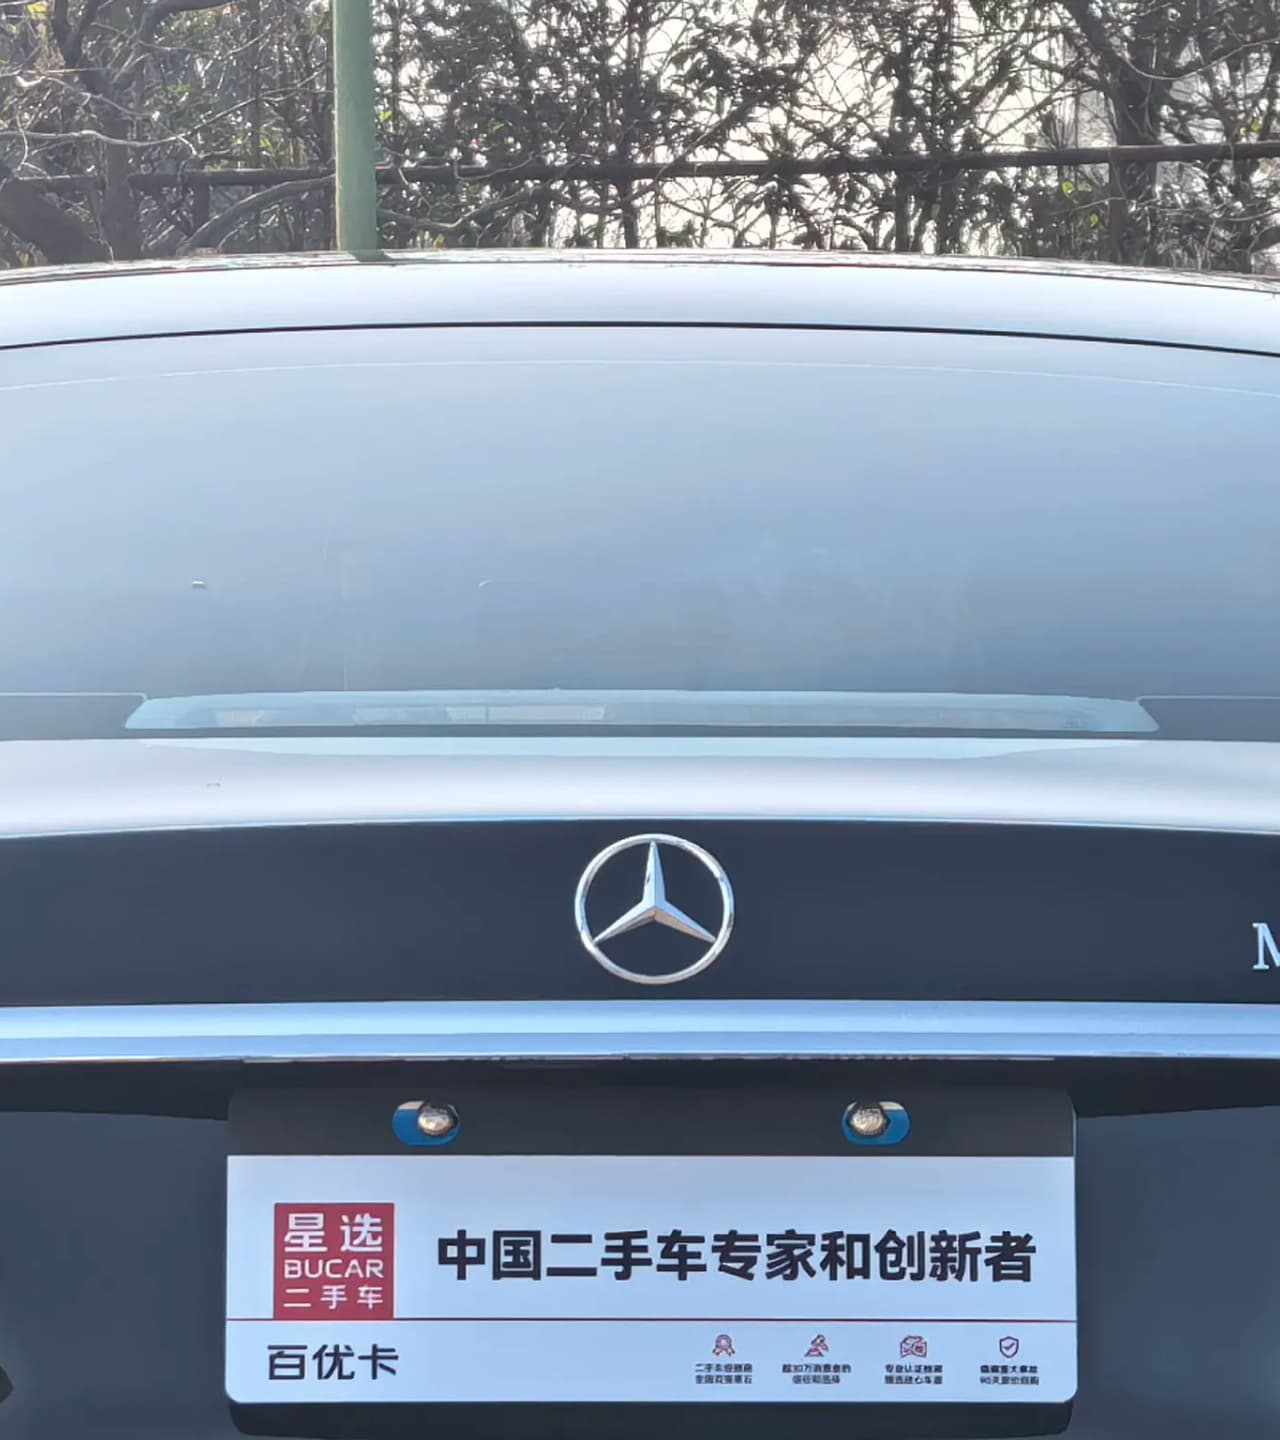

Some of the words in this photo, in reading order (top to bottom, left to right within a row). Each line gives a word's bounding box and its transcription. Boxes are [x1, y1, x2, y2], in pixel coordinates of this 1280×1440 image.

[283, 1212, 384, 1253] 星选
[283, 1259, 384, 1279] BUCAR
[437, 1228, 1037, 1283] 中国二手车专家和创新者
[282, 1284, 384, 1310] 二手车
[266, 1343, 400, 1381] 百优卡
